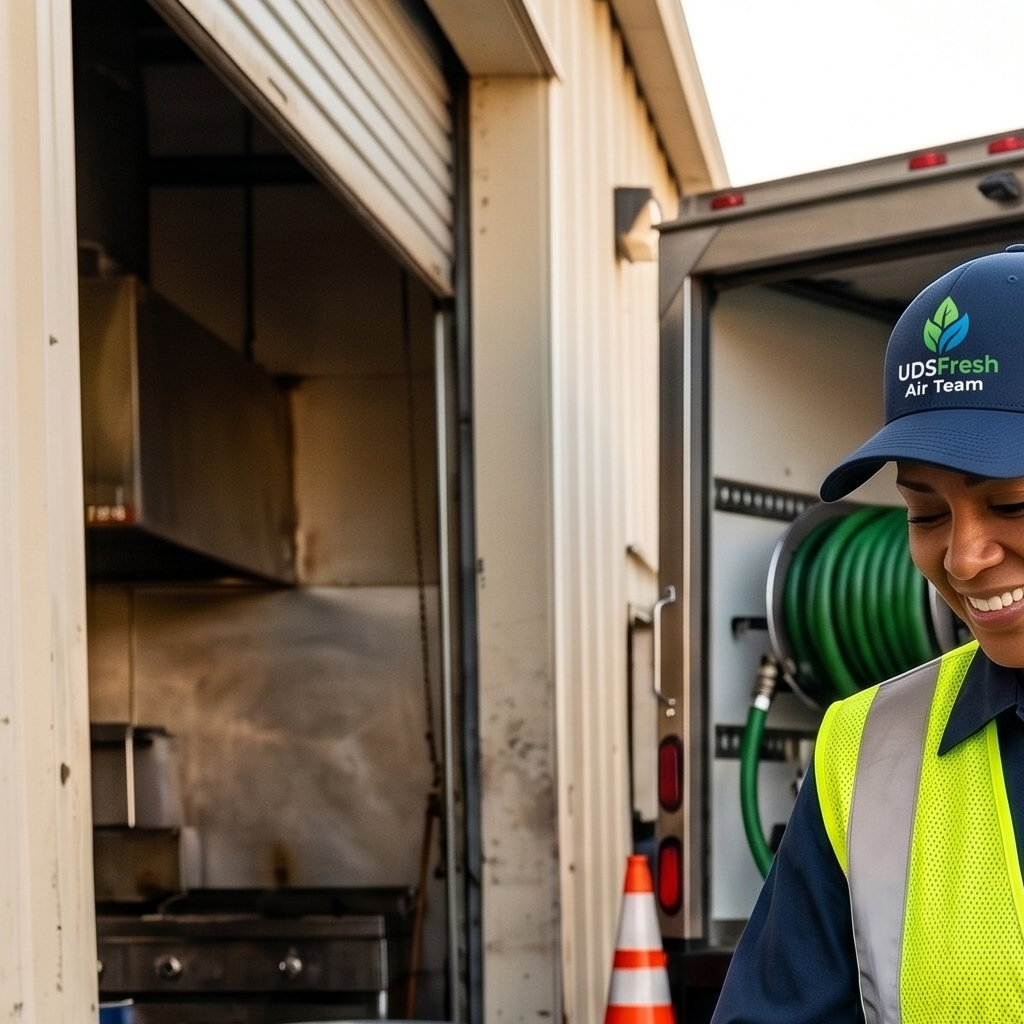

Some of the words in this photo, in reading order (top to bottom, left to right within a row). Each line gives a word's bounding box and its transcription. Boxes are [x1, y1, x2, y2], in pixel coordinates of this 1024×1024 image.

[898, 354, 999, 382] UDSFresh
[904, 381, 928, 398] Air
[933, 379, 984, 393] Team
